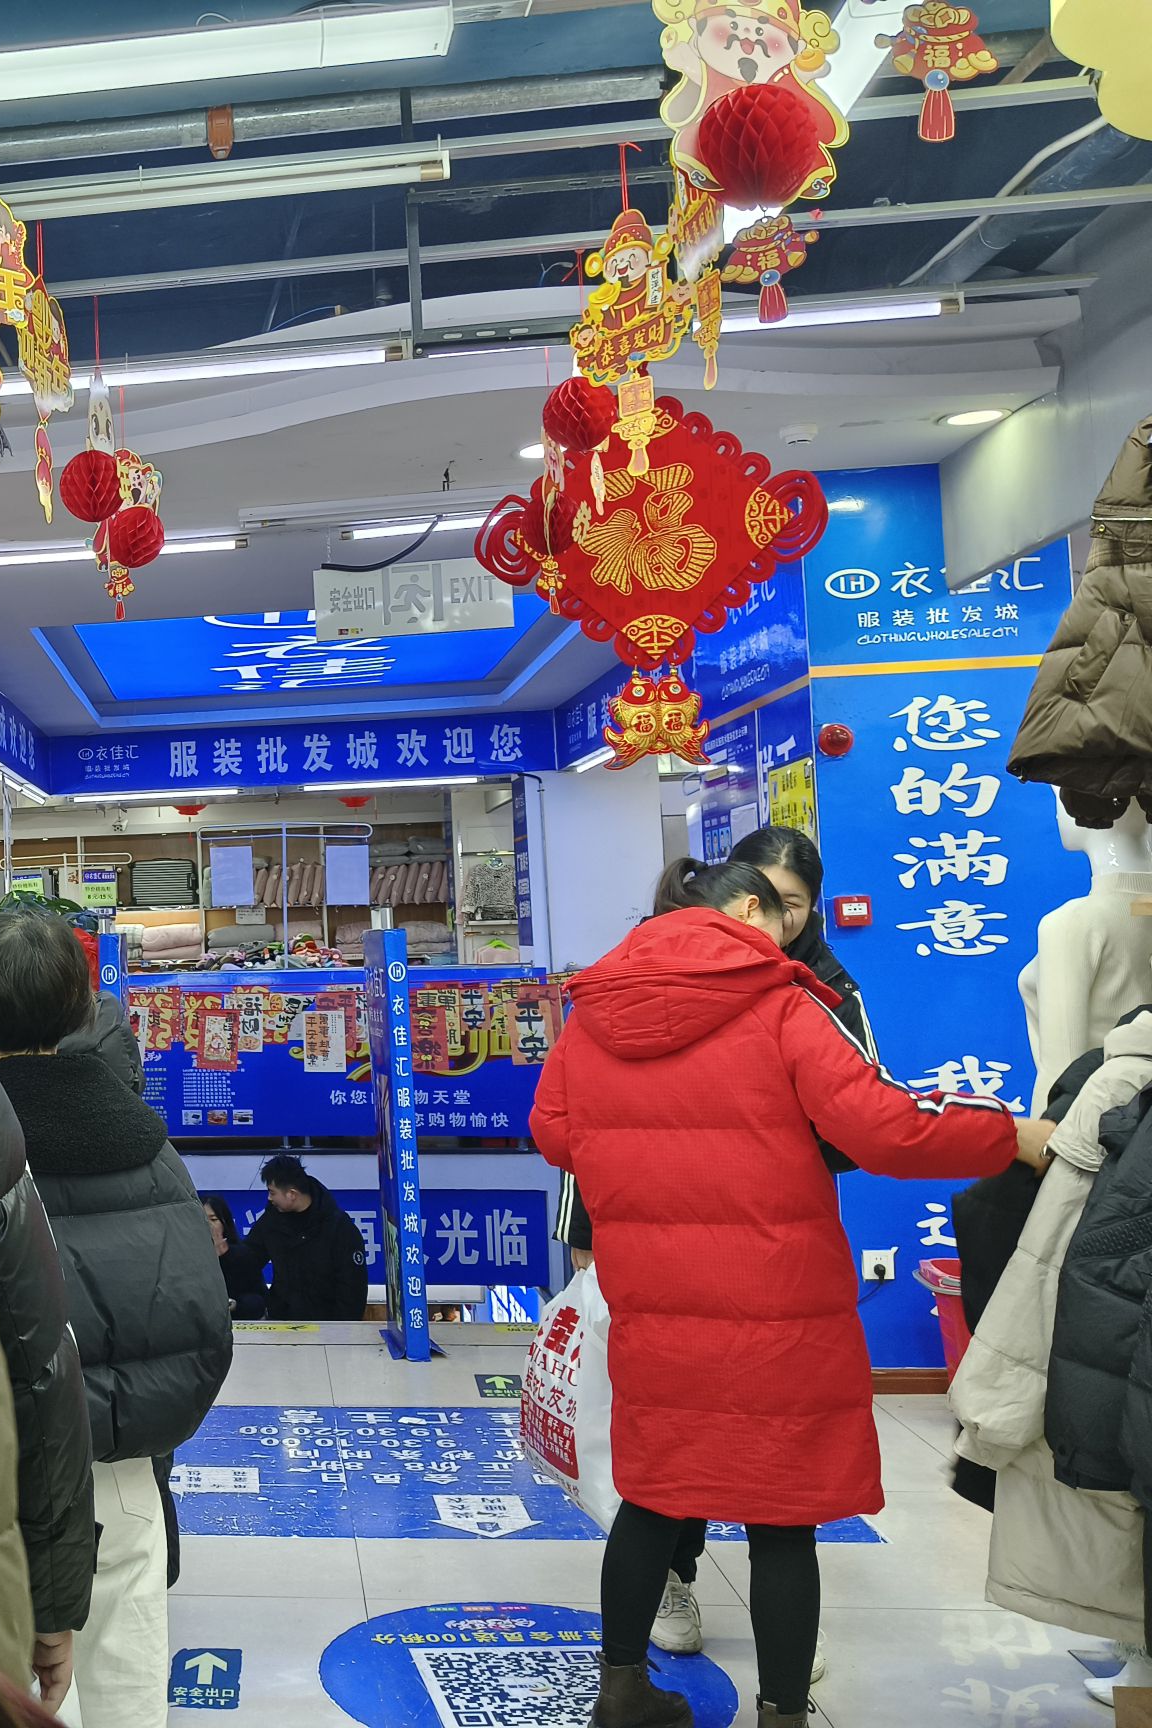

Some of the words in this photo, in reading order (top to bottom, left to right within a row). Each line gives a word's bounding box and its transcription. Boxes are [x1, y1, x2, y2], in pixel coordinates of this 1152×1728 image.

[924, 44, 950, 68] 福
[758, 251, 781, 271] 福
[596, 318, 668, 366] 恭喜发财
[330, 585, 375, 613] 安全出口
[450, 576, 496, 604] EXIT
[857, 603, 1020, 629] 服装批发城
[636, 713, 655, 733] 福
[664, 713, 684, 733] 福
[95, 745, 140, 761] 衣佳汇
[169, 724, 523, 779] 服装批发城欢迎您
[515, 1000, 549, 1063] 平安
[329, 1089, 471, 1106] 你您物天堂
[414, 1112, 510, 1129] 您购物愉快
[392, 994, 424, 1330] 衣佳汇服装批发城欢迎您
[348, 1209, 528, 1267] 再光临
[172, 1686, 235, 1698] 安全出口
[175, 1697, 230, 1706] EXIT
